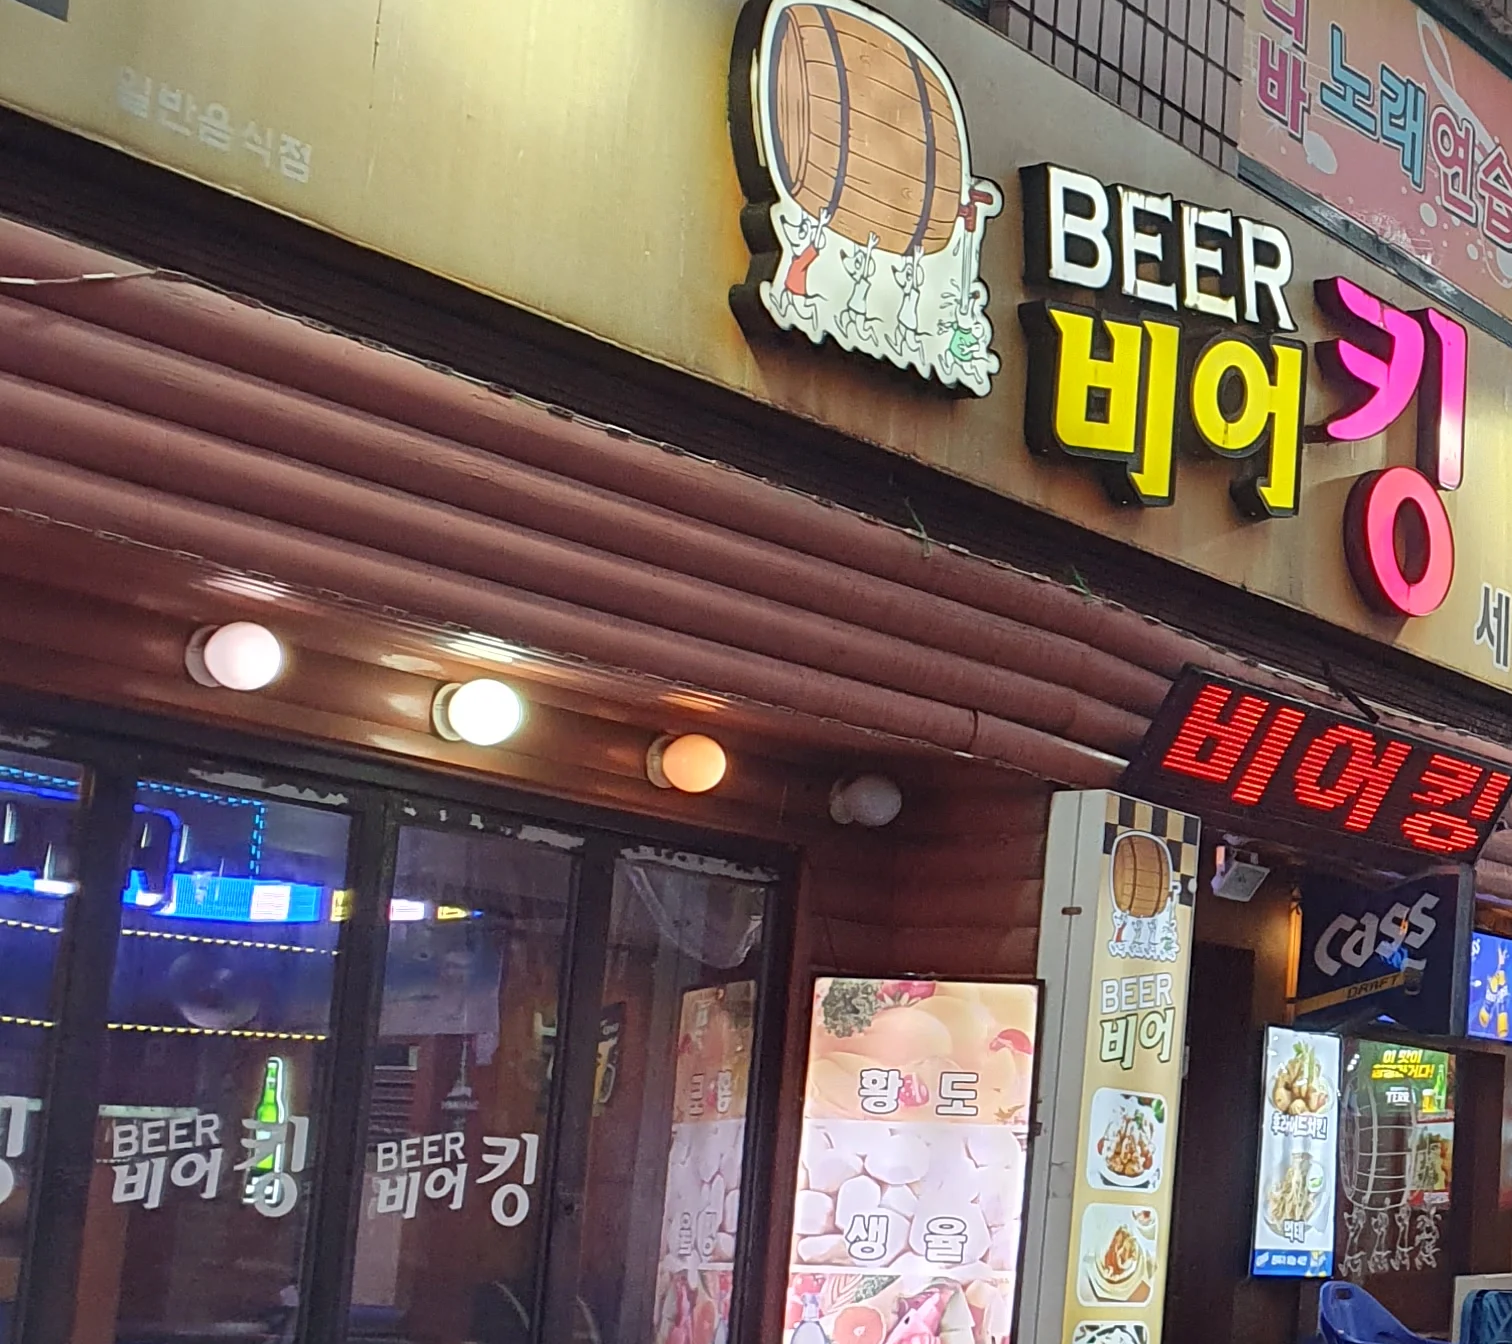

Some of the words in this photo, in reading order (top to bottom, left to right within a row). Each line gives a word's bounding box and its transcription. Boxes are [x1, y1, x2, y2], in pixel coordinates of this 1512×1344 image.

[1046, 162, 1297, 334] BEER
[1162, 683, 1512, 853] 비어킹
[1101, 972, 1173, 1015] BEER
[1099, 1006, 1176, 1071] 비어
[112, 1113, 220, 1159] BEER
[375, 1131, 466, 1174] BEER
